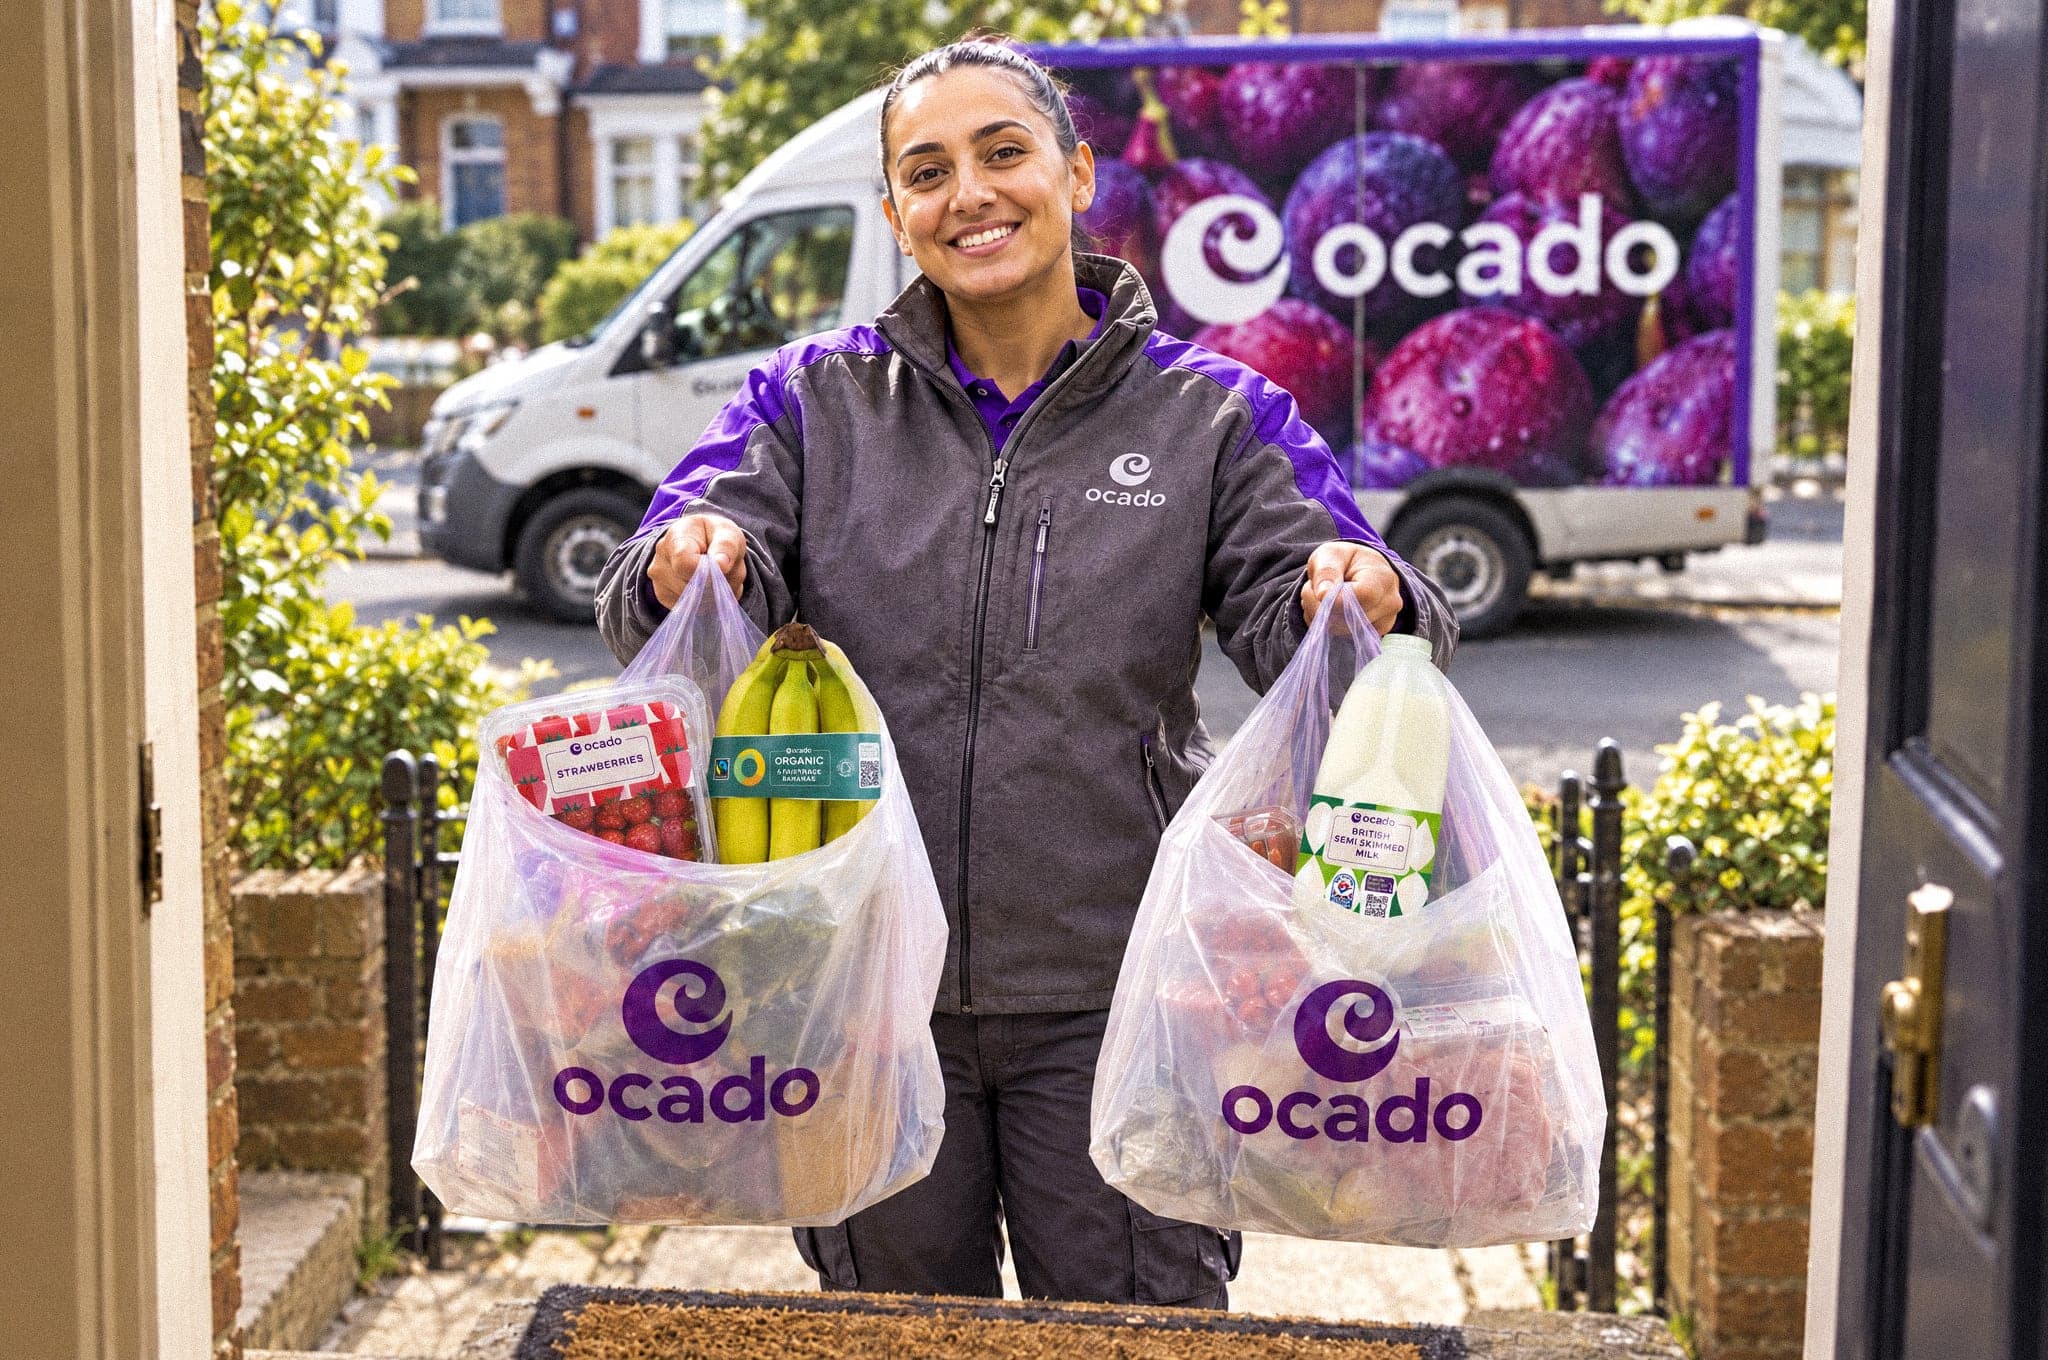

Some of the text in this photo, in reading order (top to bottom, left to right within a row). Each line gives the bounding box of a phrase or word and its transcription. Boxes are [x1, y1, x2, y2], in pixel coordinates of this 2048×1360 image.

[1312, 192, 1680, 298] ocado
[1085, 488, 1166, 507] ocado
[584, 736, 622, 751] ocado
[557, 754, 644, 778] STRAWBERRIES
[774, 756, 824, 765] ORGANIC
[1362, 815, 1395, 827] ocado
[1352, 827, 1390, 840] BRITISH
[1334, 834, 1405, 852] SEMI SKIMMED
[1355, 849, 1379, 859] MILK
[553, 1055, 821, 1124] ocado
[1221, 1077, 1483, 1144] ocado
